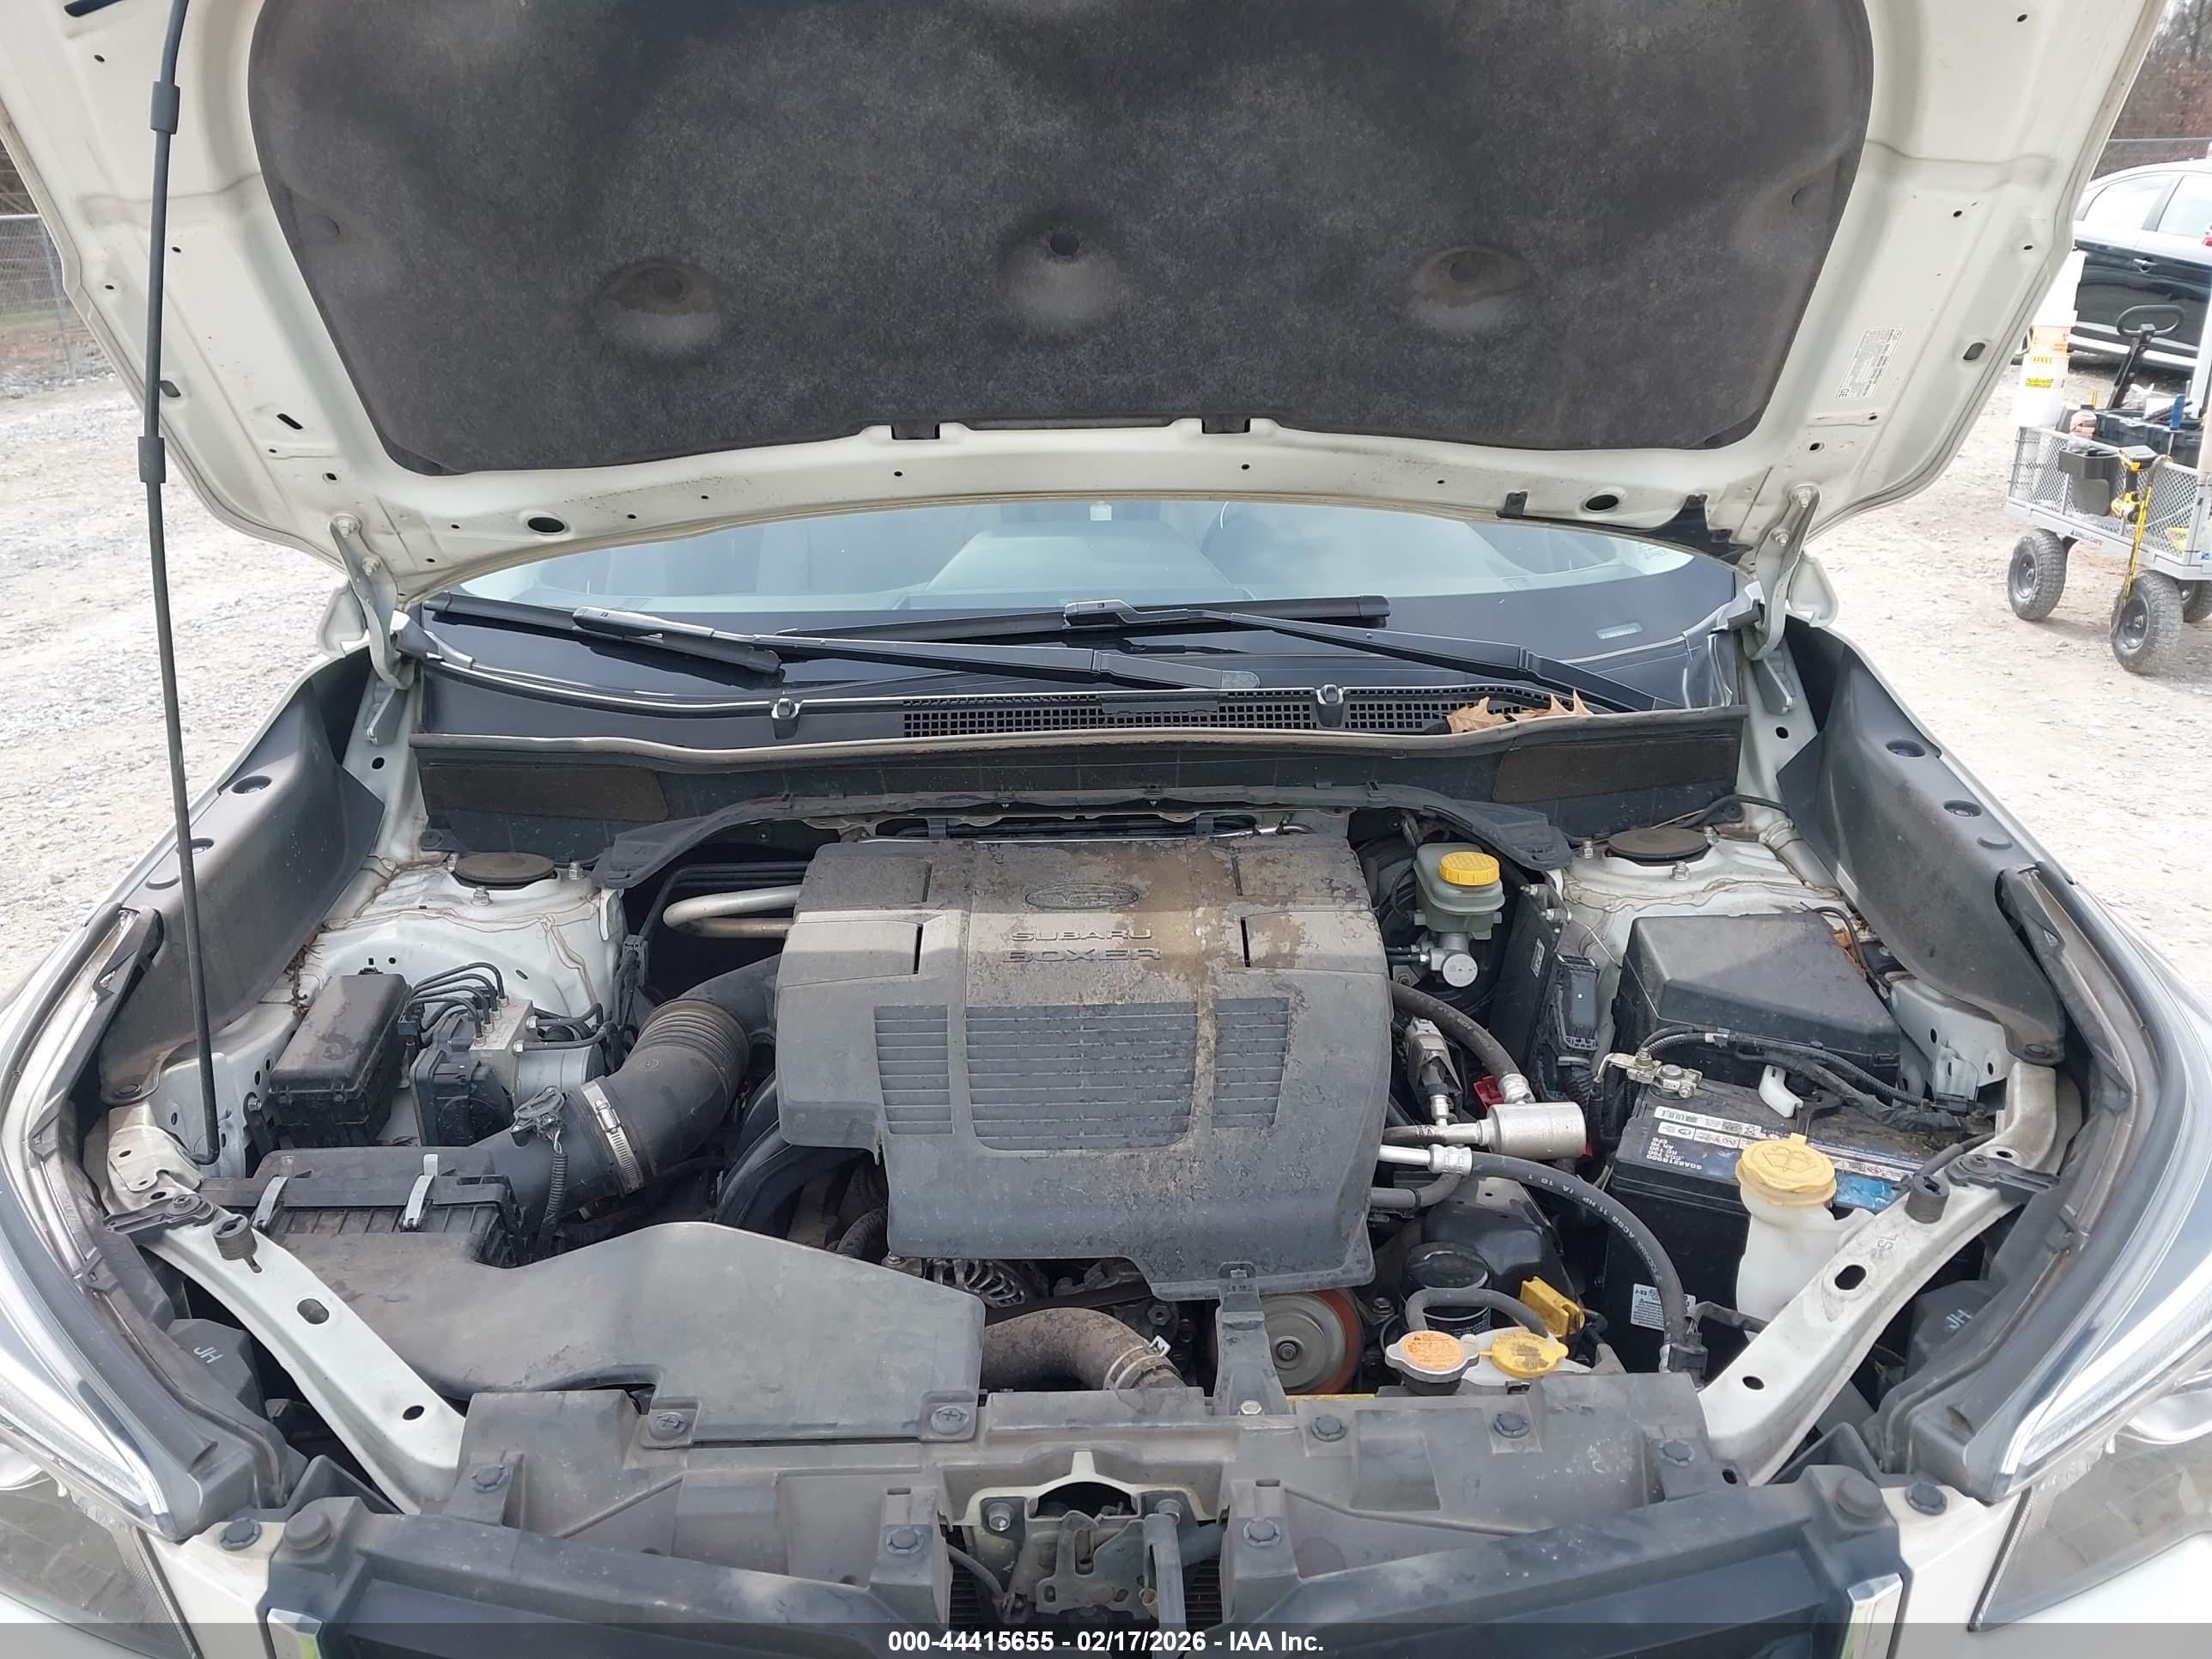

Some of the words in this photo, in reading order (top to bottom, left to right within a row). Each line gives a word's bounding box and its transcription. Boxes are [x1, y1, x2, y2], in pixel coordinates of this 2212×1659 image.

[1011, 928, 1152, 942] SUBARU
[1001, 946, 1162, 963] BOXER
[1582, 1196, 1597, 1207] HP
[1946, 1309, 1972, 1329] JH
[193, 1346, 224, 1364] JH
